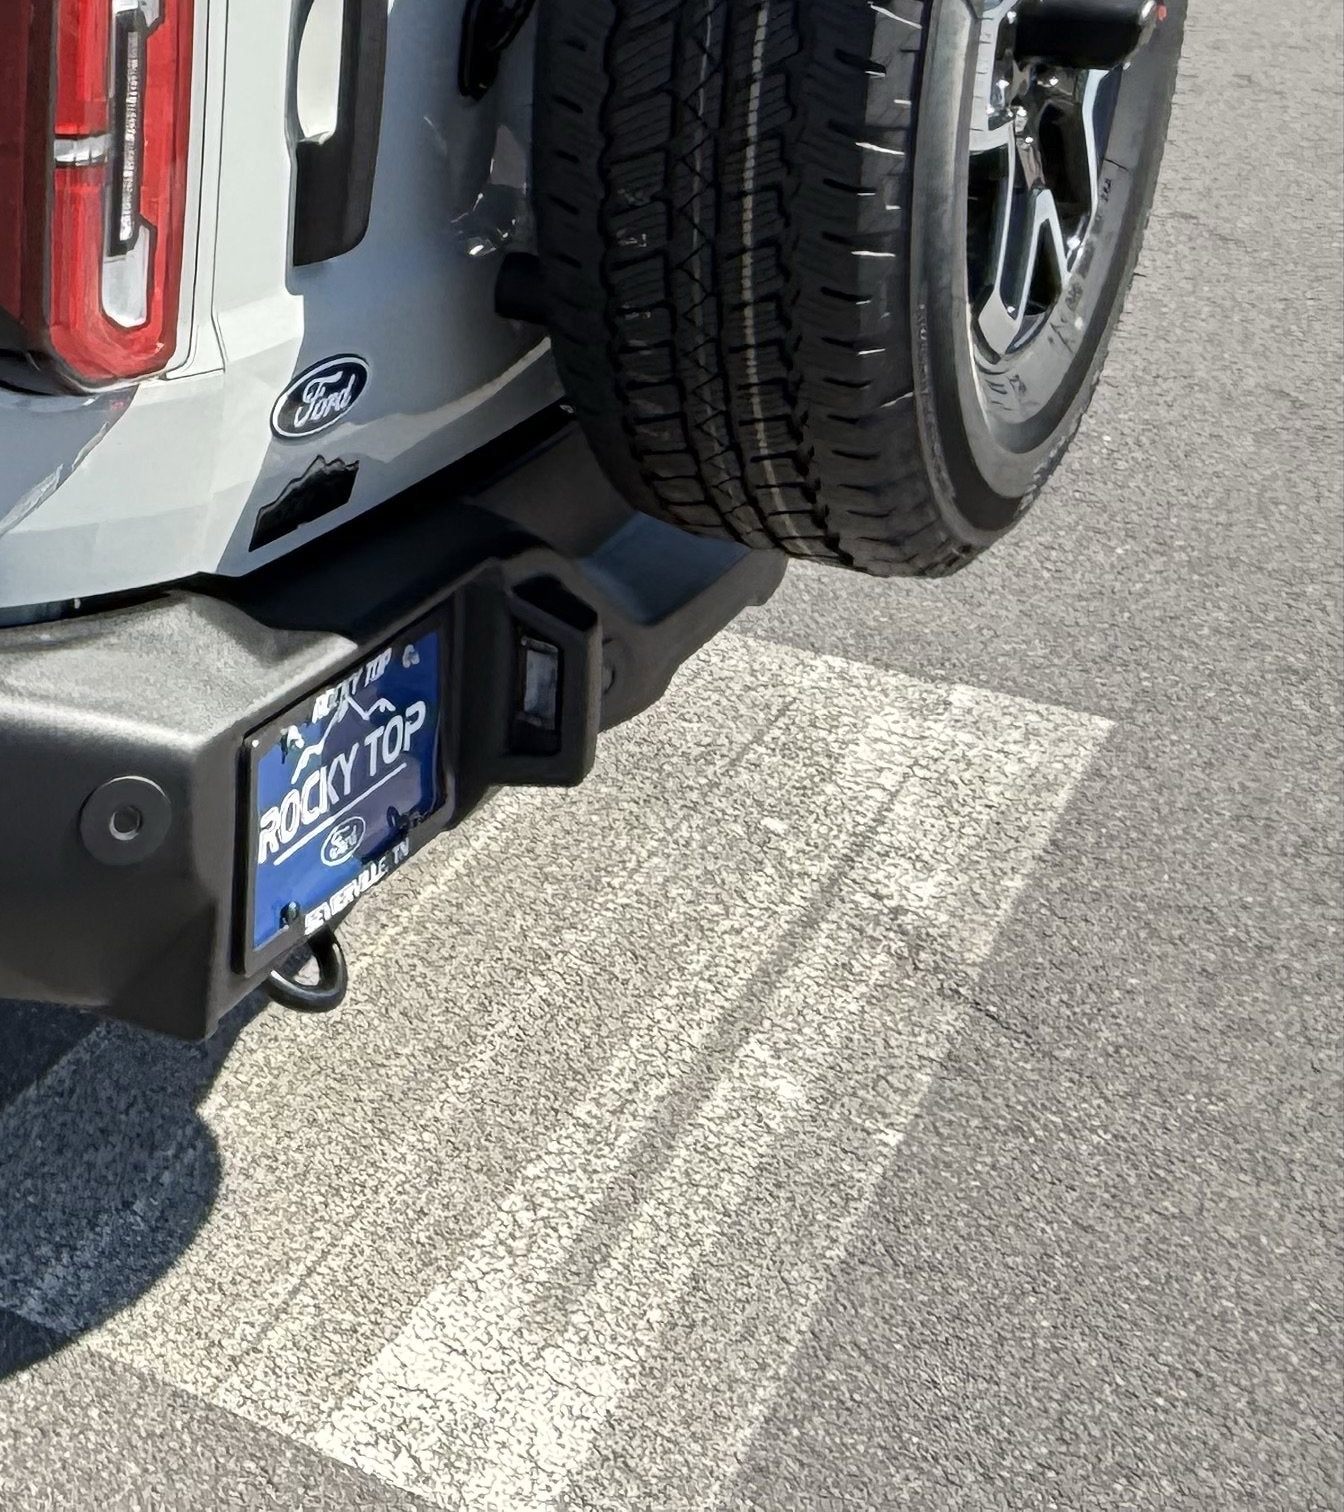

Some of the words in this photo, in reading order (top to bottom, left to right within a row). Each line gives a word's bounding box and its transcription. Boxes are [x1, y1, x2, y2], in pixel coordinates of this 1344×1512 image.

[294, 370, 356, 428] Ford
[364, 647, 393, 687] TOP
[257, 741, 360, 865] ROCKY
[364, 700, 426, 777] TOP
[392, 837, 410, 865] TN
